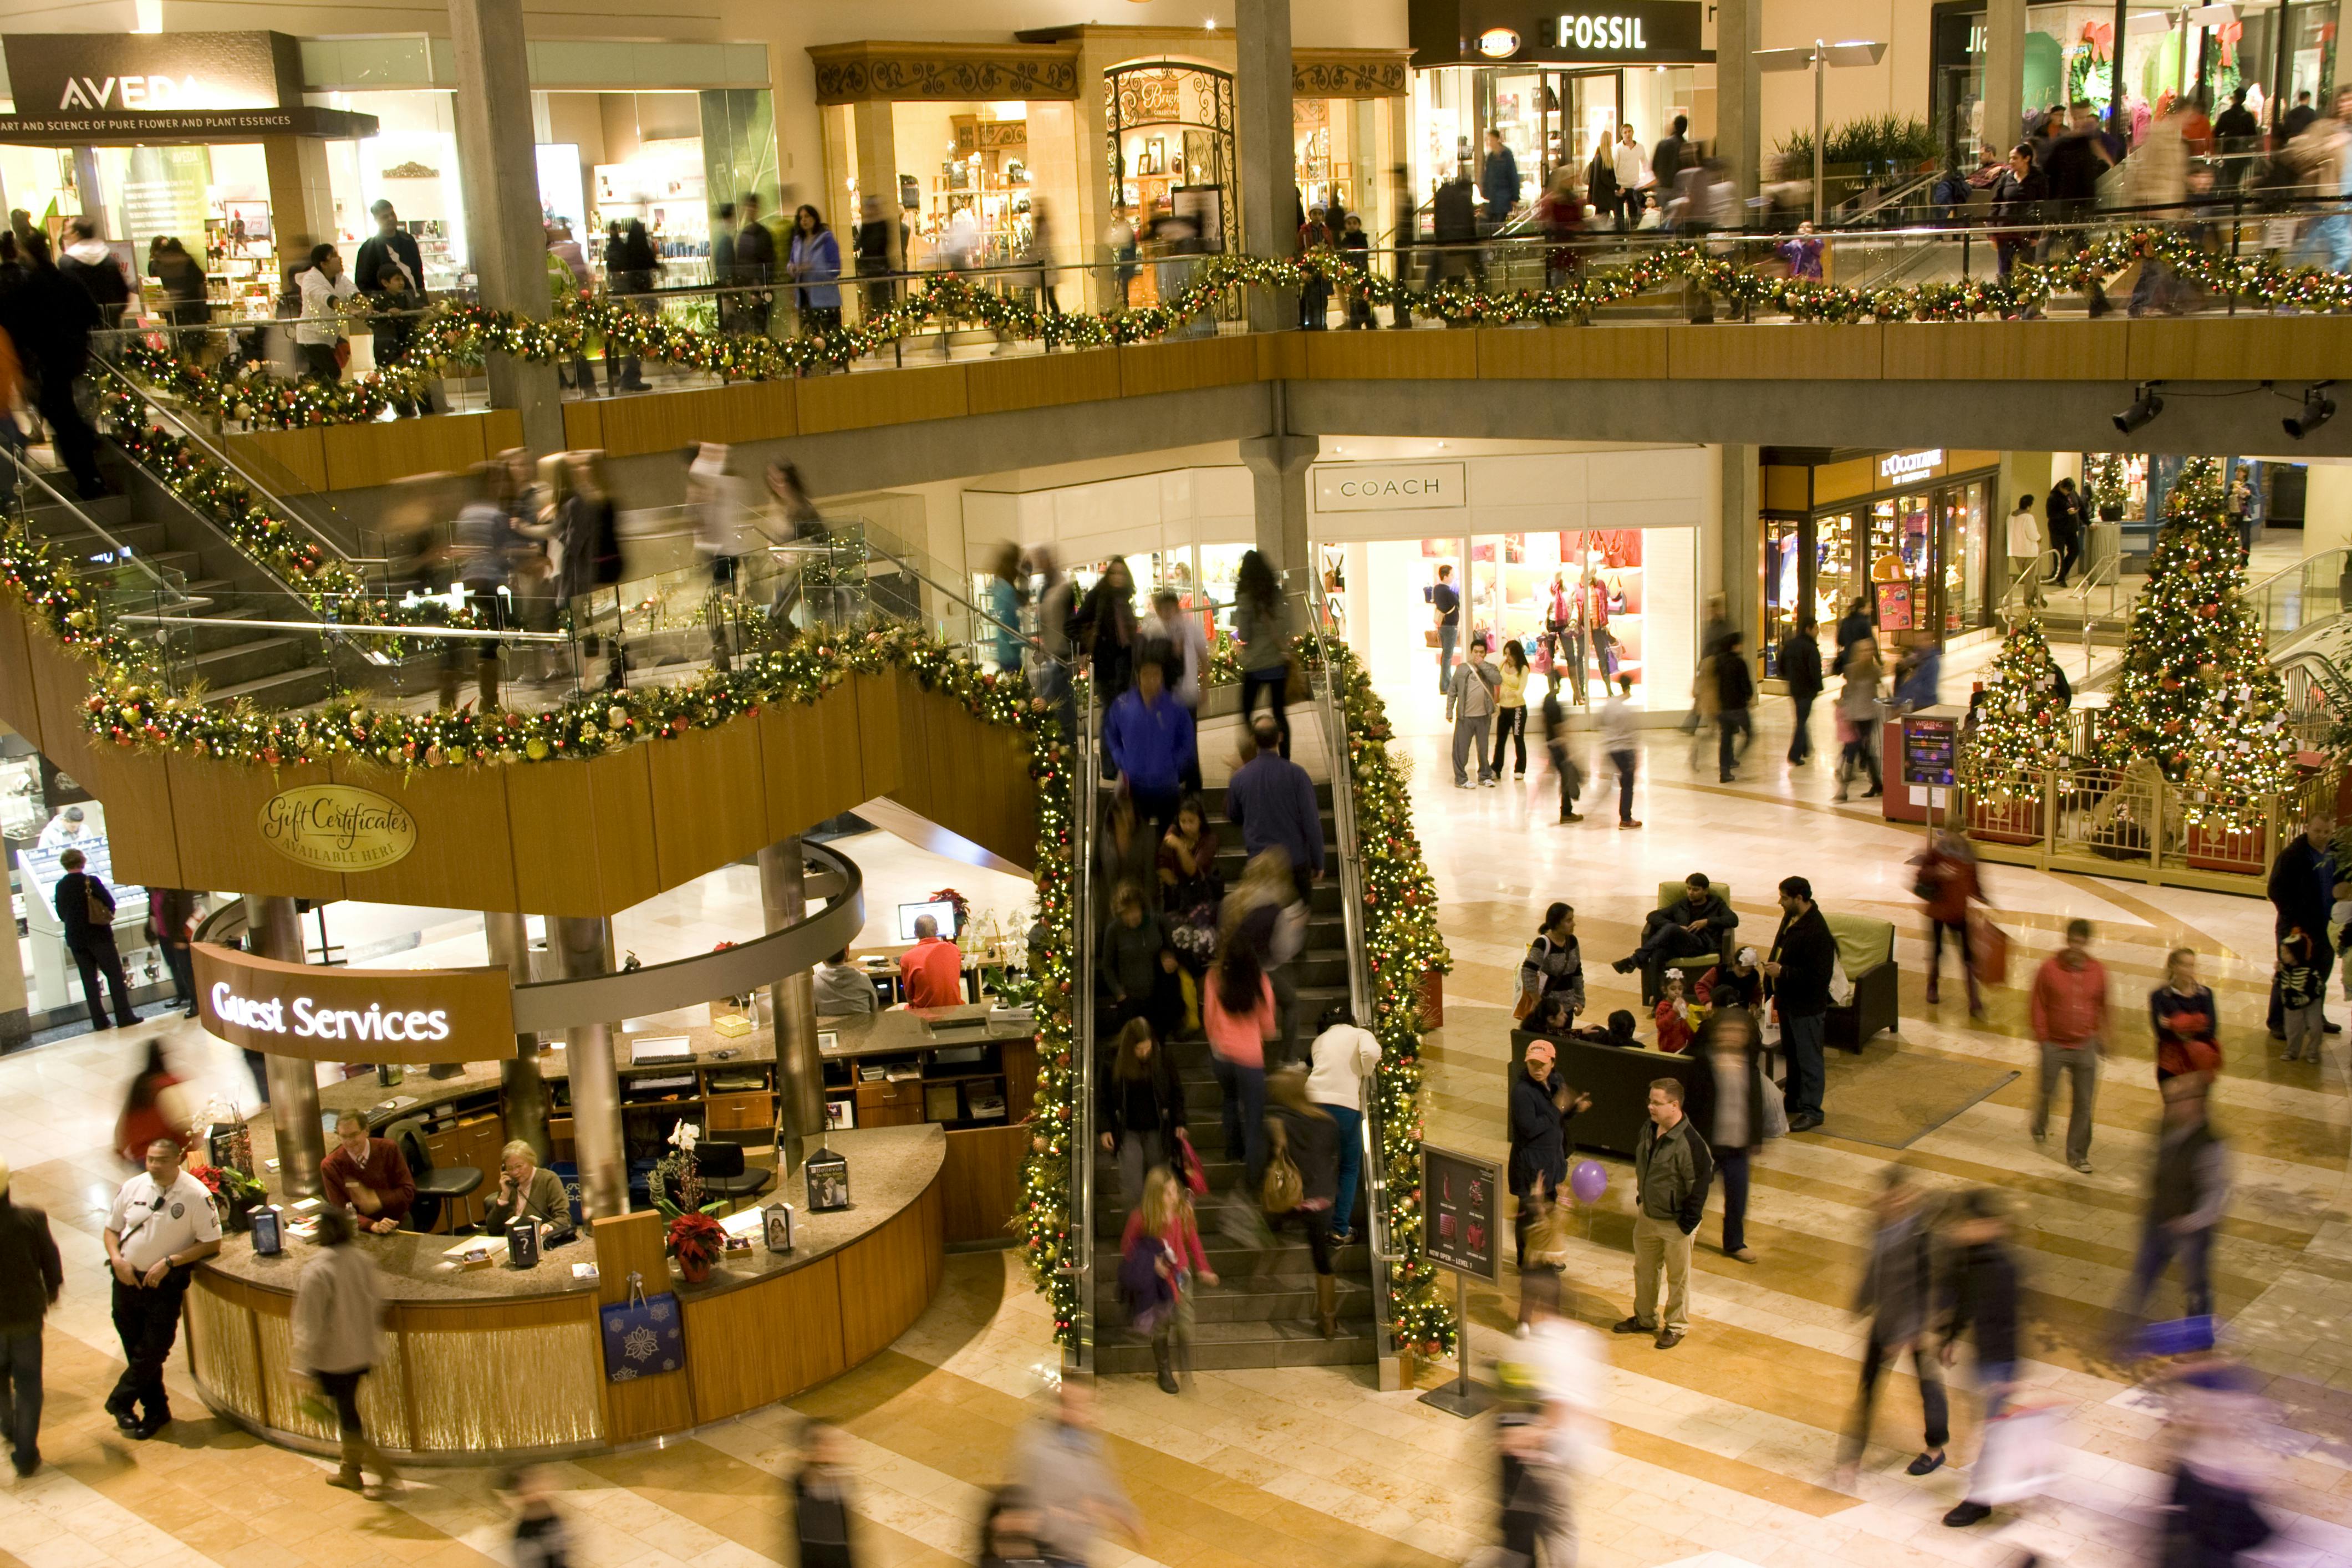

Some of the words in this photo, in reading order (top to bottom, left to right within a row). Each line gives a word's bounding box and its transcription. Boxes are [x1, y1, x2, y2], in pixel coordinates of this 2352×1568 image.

[1560, 15, 1646, 49] FOSSIL
[59, 75, 205, 110] AVEDA
[1142, 82, 1193, 108] Brigh
[1, 121, 19, 131] ART
[23, 121, 44, 131] AND
[47, 120, 90, 131] SCIENCE
[93, 120, 107, 130] OF
[110, 119, 136, 129] PURE
[139, 119, 179, 129] FLOWER
[182, 118, 203, 128] AND
[206, 117, 237, 127] PLANT
[240, 115, 291, 126] ESSENCES
[1341, 478, 1439, 497] COACH
[264, 797, 312, 842] Gift
[312, 797, 409, 850] Certificates
[282, 838, 357, 863] AVAILABLE
[363, 842, 396, 862] HERE
[212, 981, 287, 1034] Guest
[292, 997, 449, 1041] Services
[1429, 1249, 1439, 1258] NOW
[1440, 1252, 1451, 1261] OPEN
[1455, 1258, 1468, 1268] LEVEL
